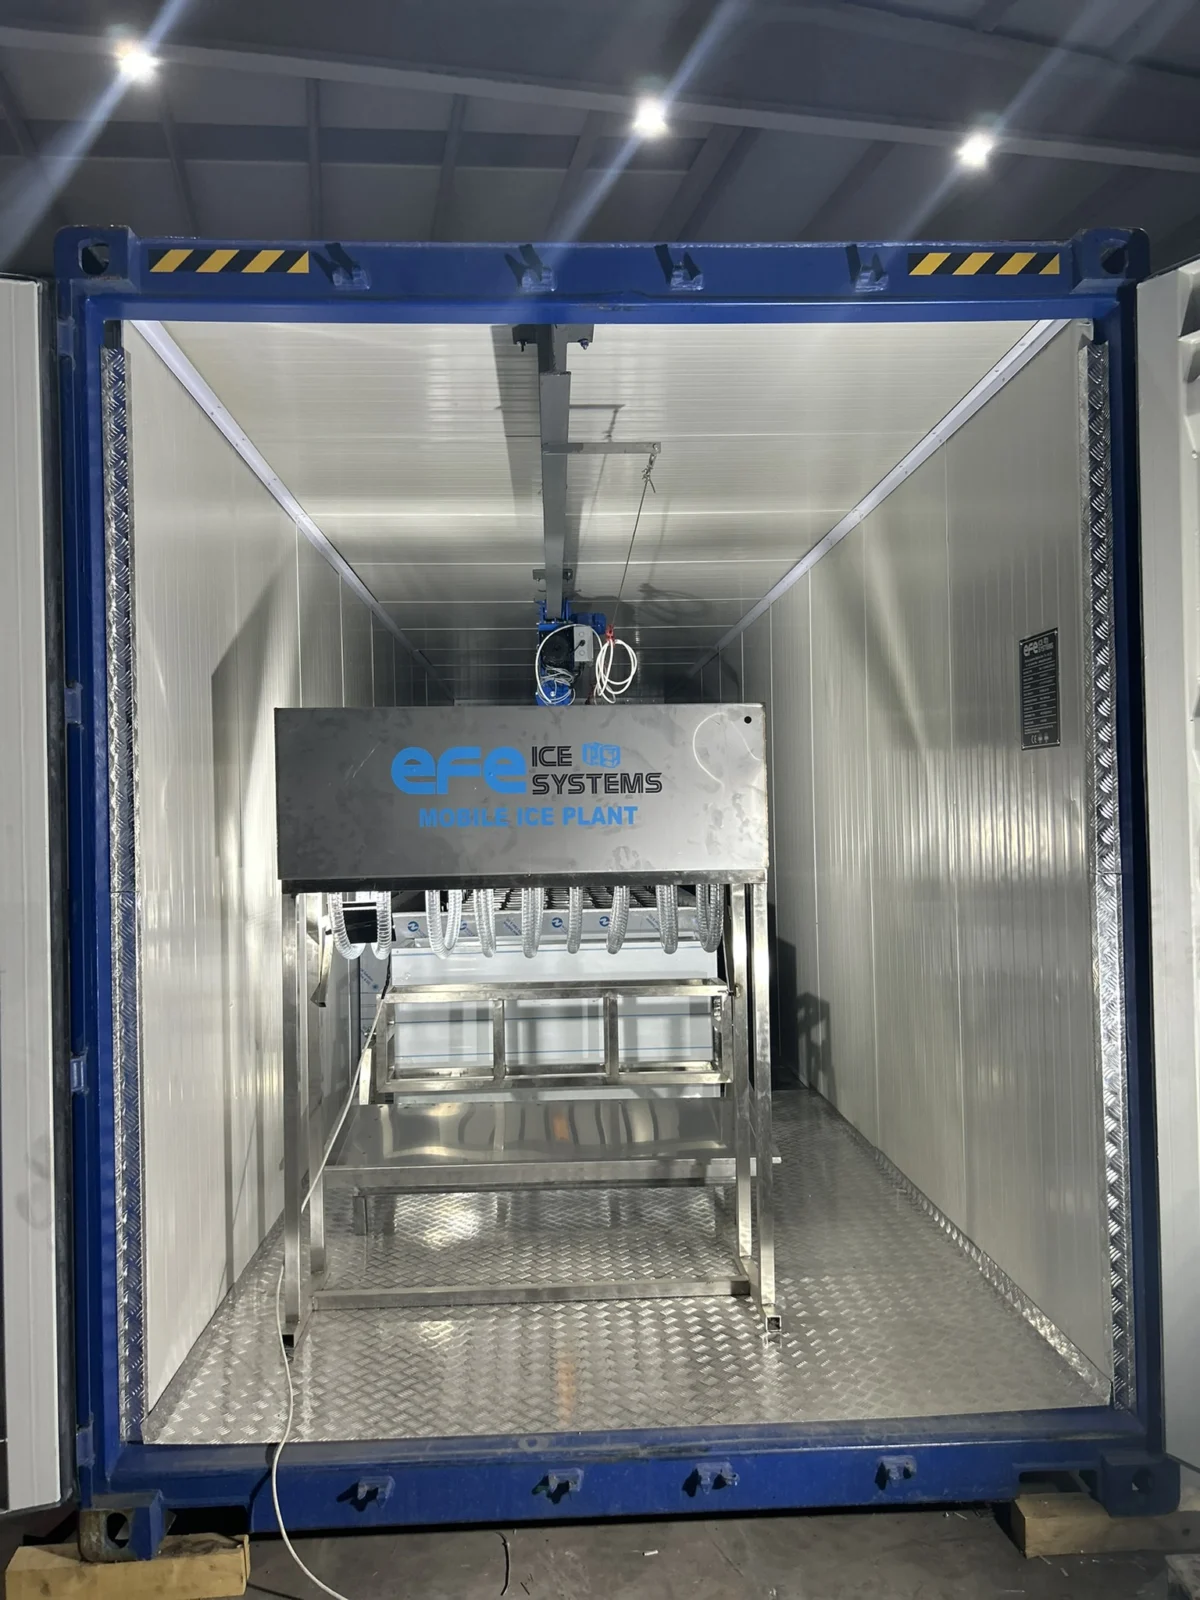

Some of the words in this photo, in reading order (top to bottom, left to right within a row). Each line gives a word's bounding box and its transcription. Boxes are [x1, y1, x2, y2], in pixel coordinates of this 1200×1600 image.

[532, 745, 572, 767] ICE
[532, 772, 663, 794] SYSTEMS
[419, 807, 508, 827] MOBILE
[517, 806, 554, 826] ICE
[563, 806, 638, 826] PLANT
